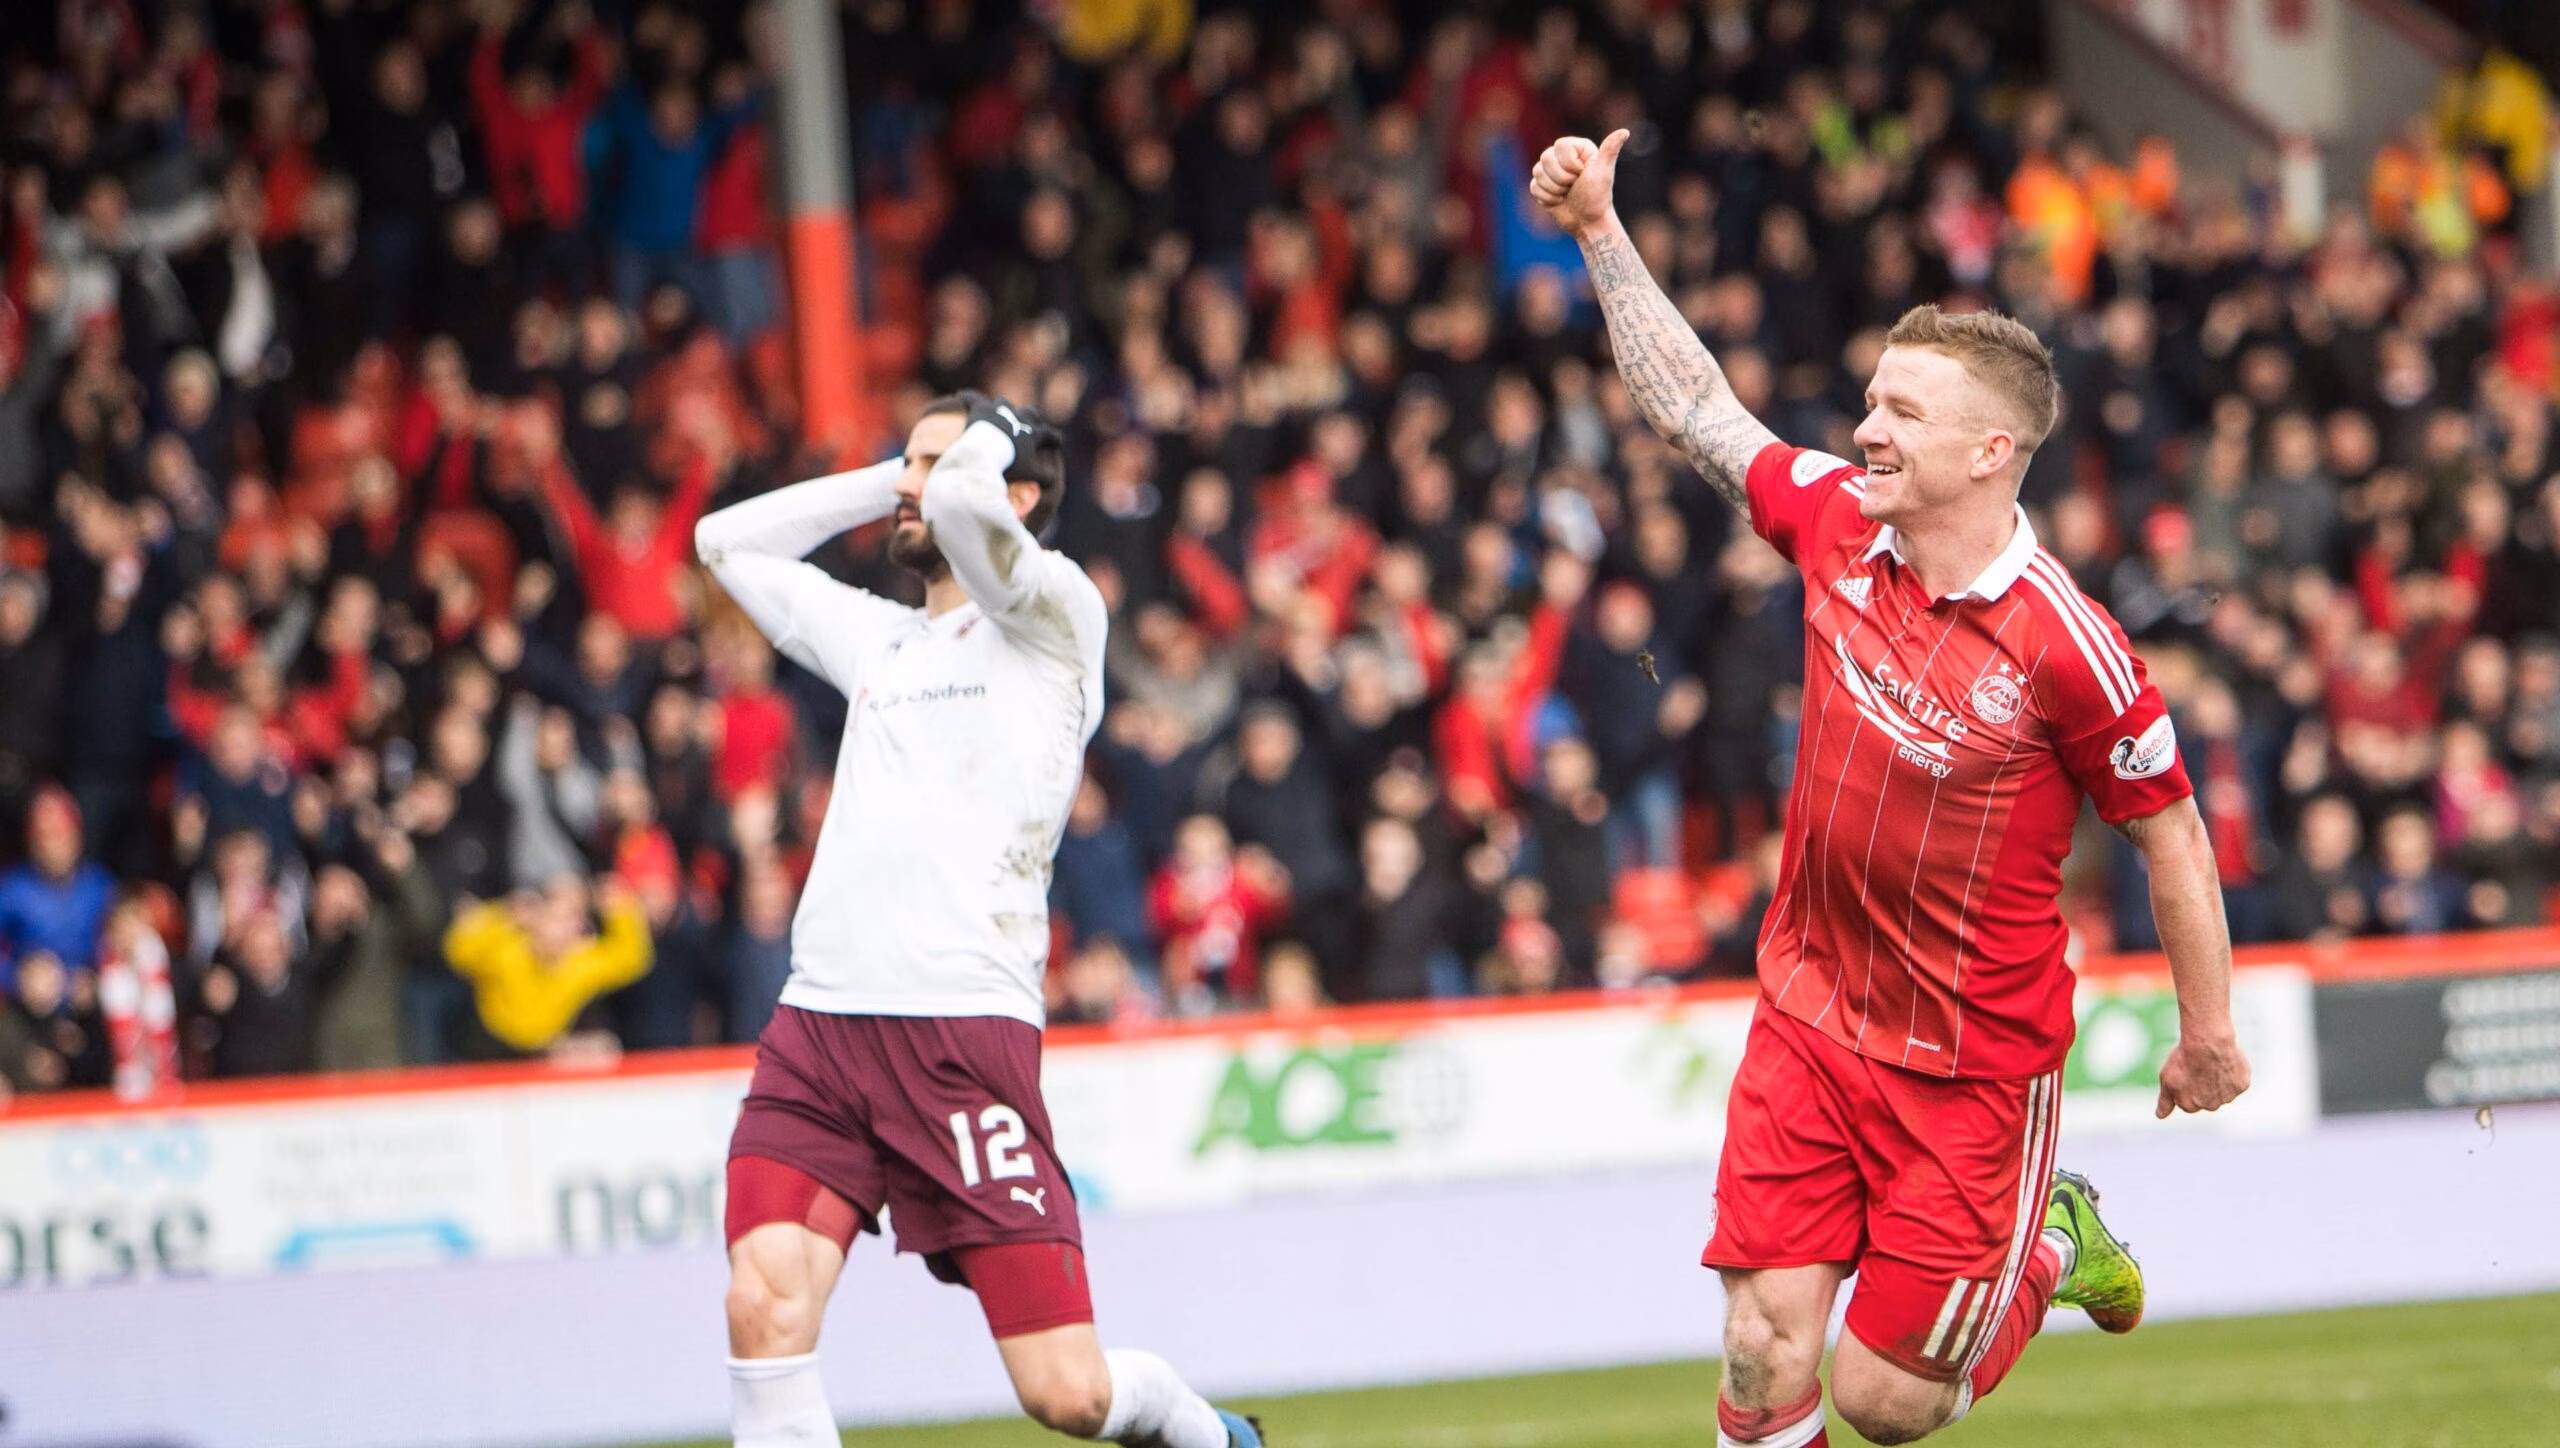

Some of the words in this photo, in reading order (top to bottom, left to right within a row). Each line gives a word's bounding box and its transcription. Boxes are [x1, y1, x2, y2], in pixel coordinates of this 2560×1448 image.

[1873, 663, 1969, 741] Saltire
[1898, 746, 1953, 779] energy
[949, 1104, 1036, 1189] 12
